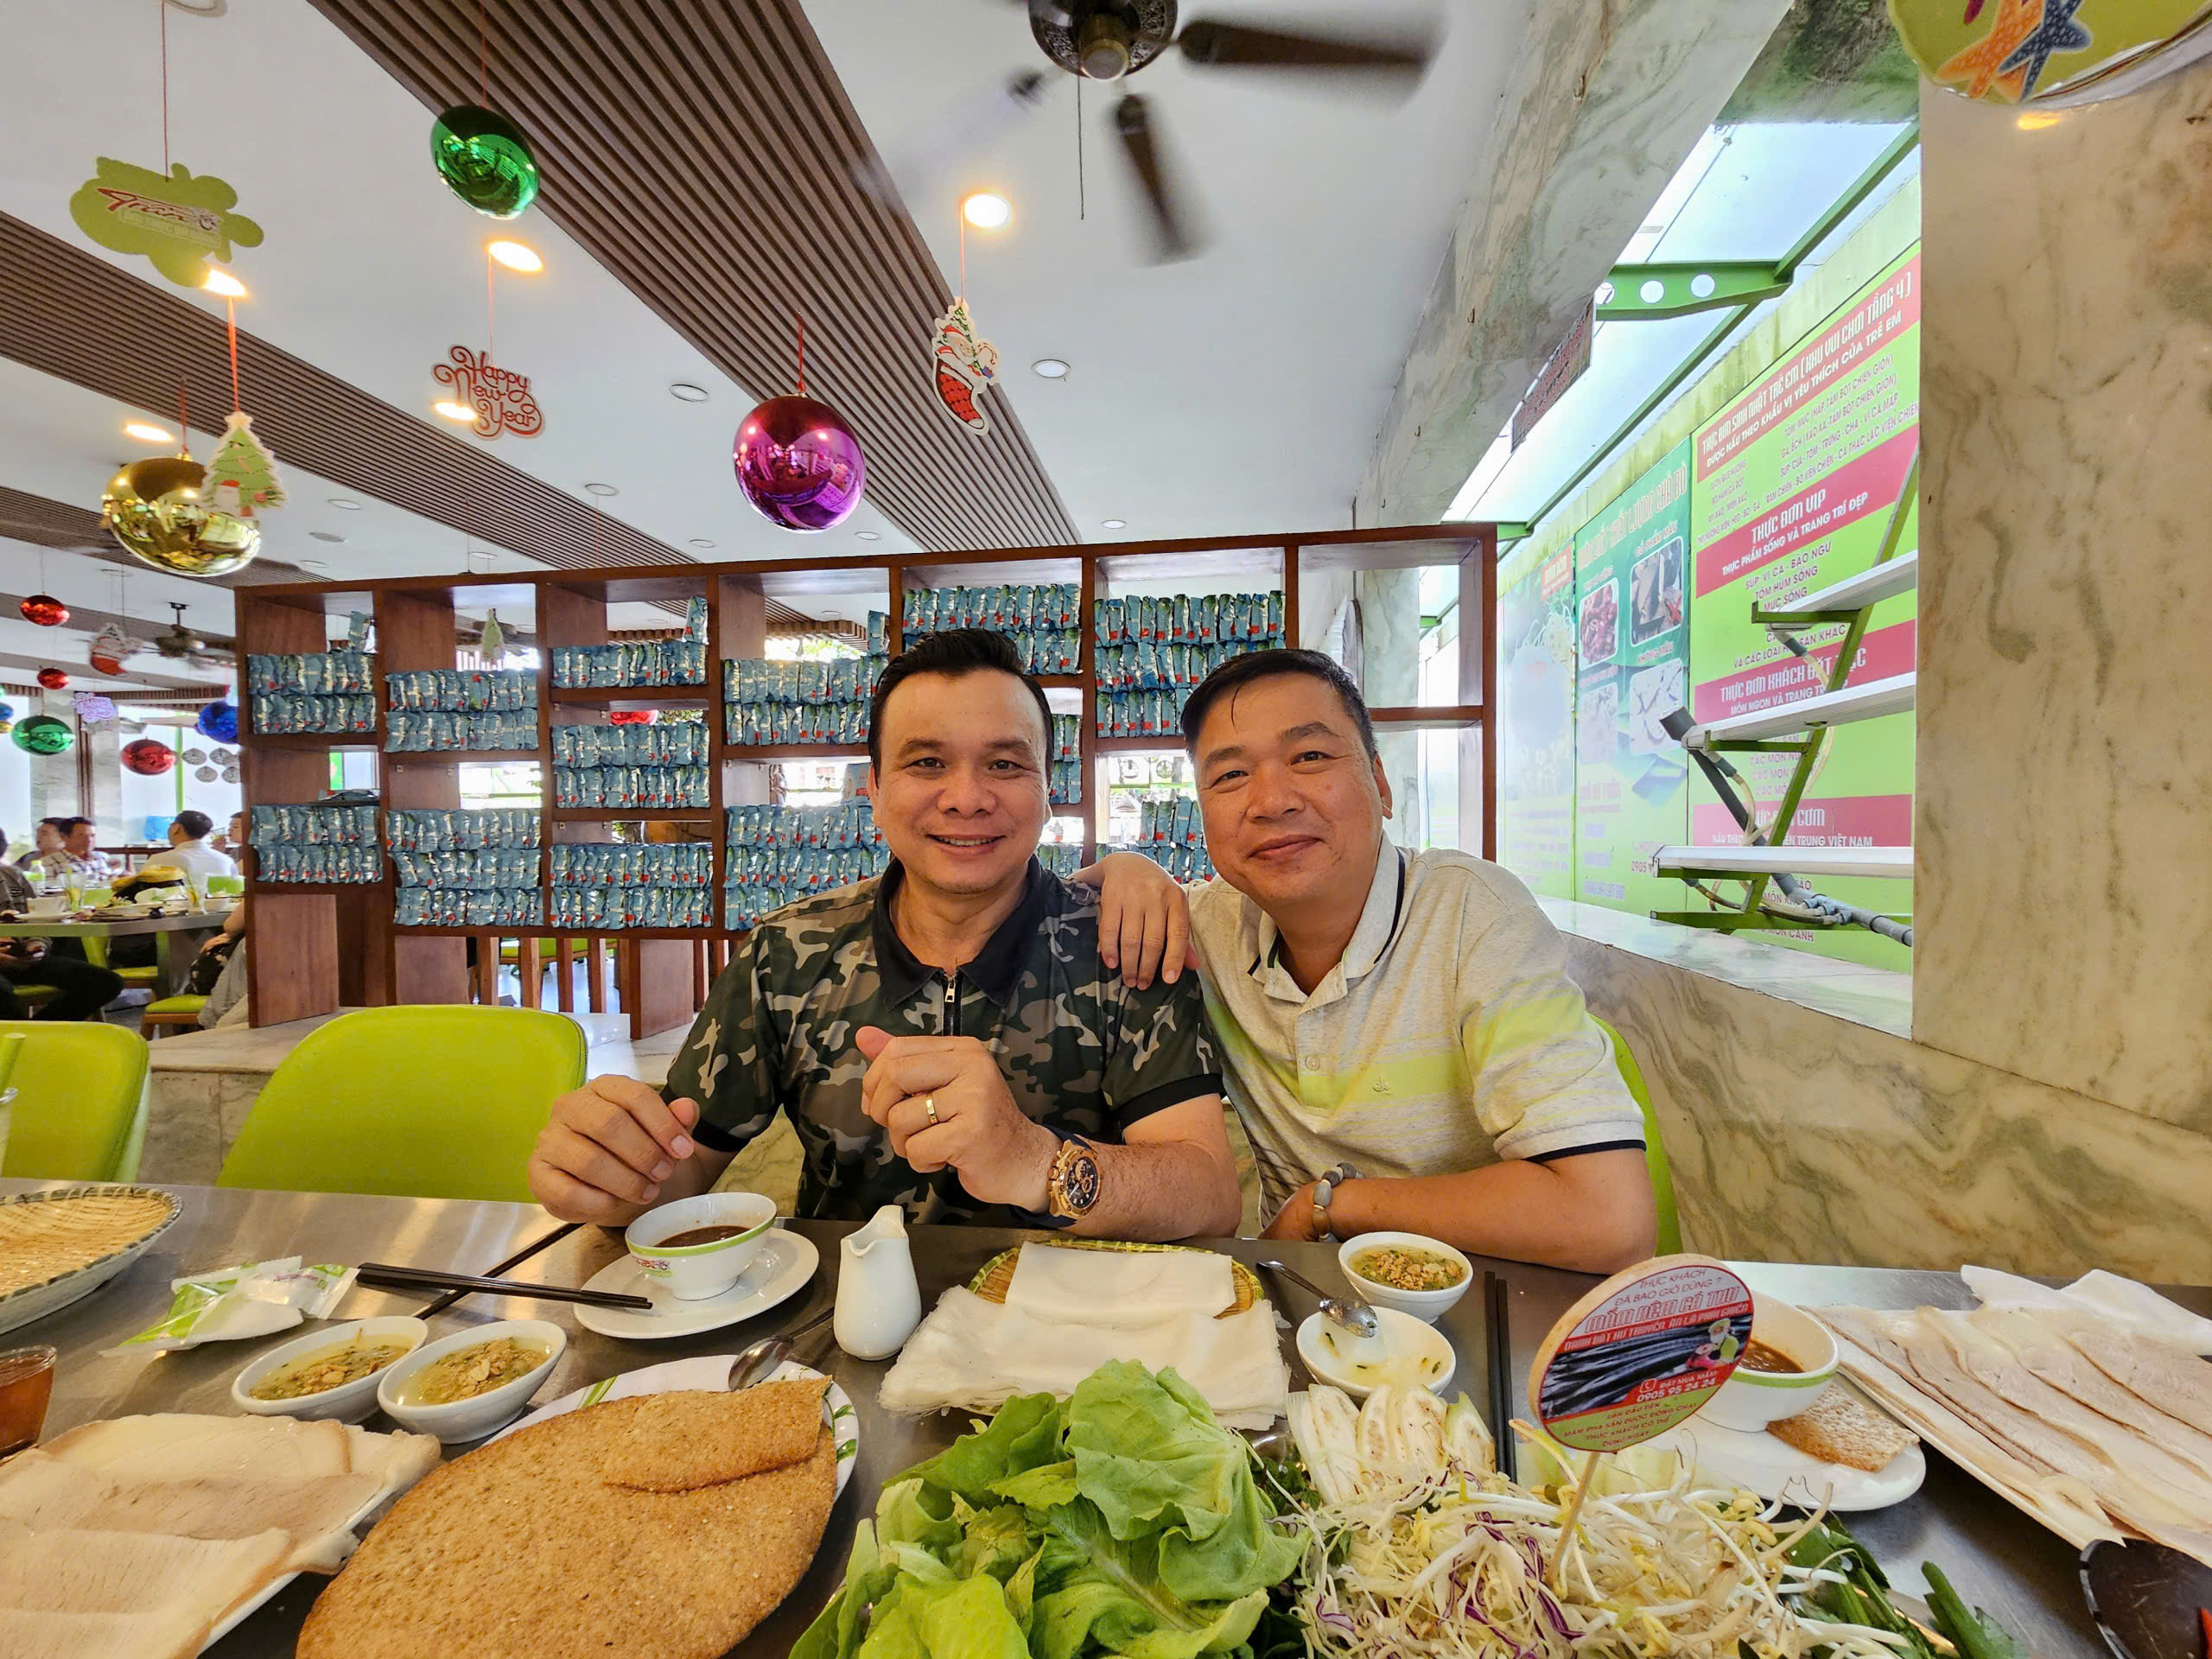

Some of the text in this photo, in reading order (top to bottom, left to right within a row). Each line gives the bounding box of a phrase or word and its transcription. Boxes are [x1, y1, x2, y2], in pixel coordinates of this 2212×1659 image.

[434, 364, 506, 415] New
[450, 346, 529, 403] Happy
[1707, 308, 1901, 467] ĐƯỢC NẤU THEO KHẨU VỊ YÊU THÍCH CỦA TRẺ EM
[472, 398, 536, 437] Year
[1722, 491, 1867, 576] THỰC PHẨM SỐNG VÀ TRANG TRÍ ĐẸP
[1751, 515, 1777, 544] THỰC
[1781, 500, 1802, 529] ĐƠN
[1805, 487, 1825, 515] VIP
[1721, 680, 1744, 702] THỰC
[1745, 674, 1765, 696] ĐƠN
[1768, 663, 1804, 690] KHÁCH
[1797, 807, 1825, 826] CƠM
[1797, 835, 1825, 846] TRUNG
[1828, 832, 1847, 847] VIỆT
[1848, 835, 1872, 847] NAM
[1585, 1306, 1634, 1333] MẮM
[1635, 1298, 1678, 1322] NÊM
[1707, 1285, 1739, 1306] THU
[1637, 1377, 1715, 1402] 0905 95 24 24
